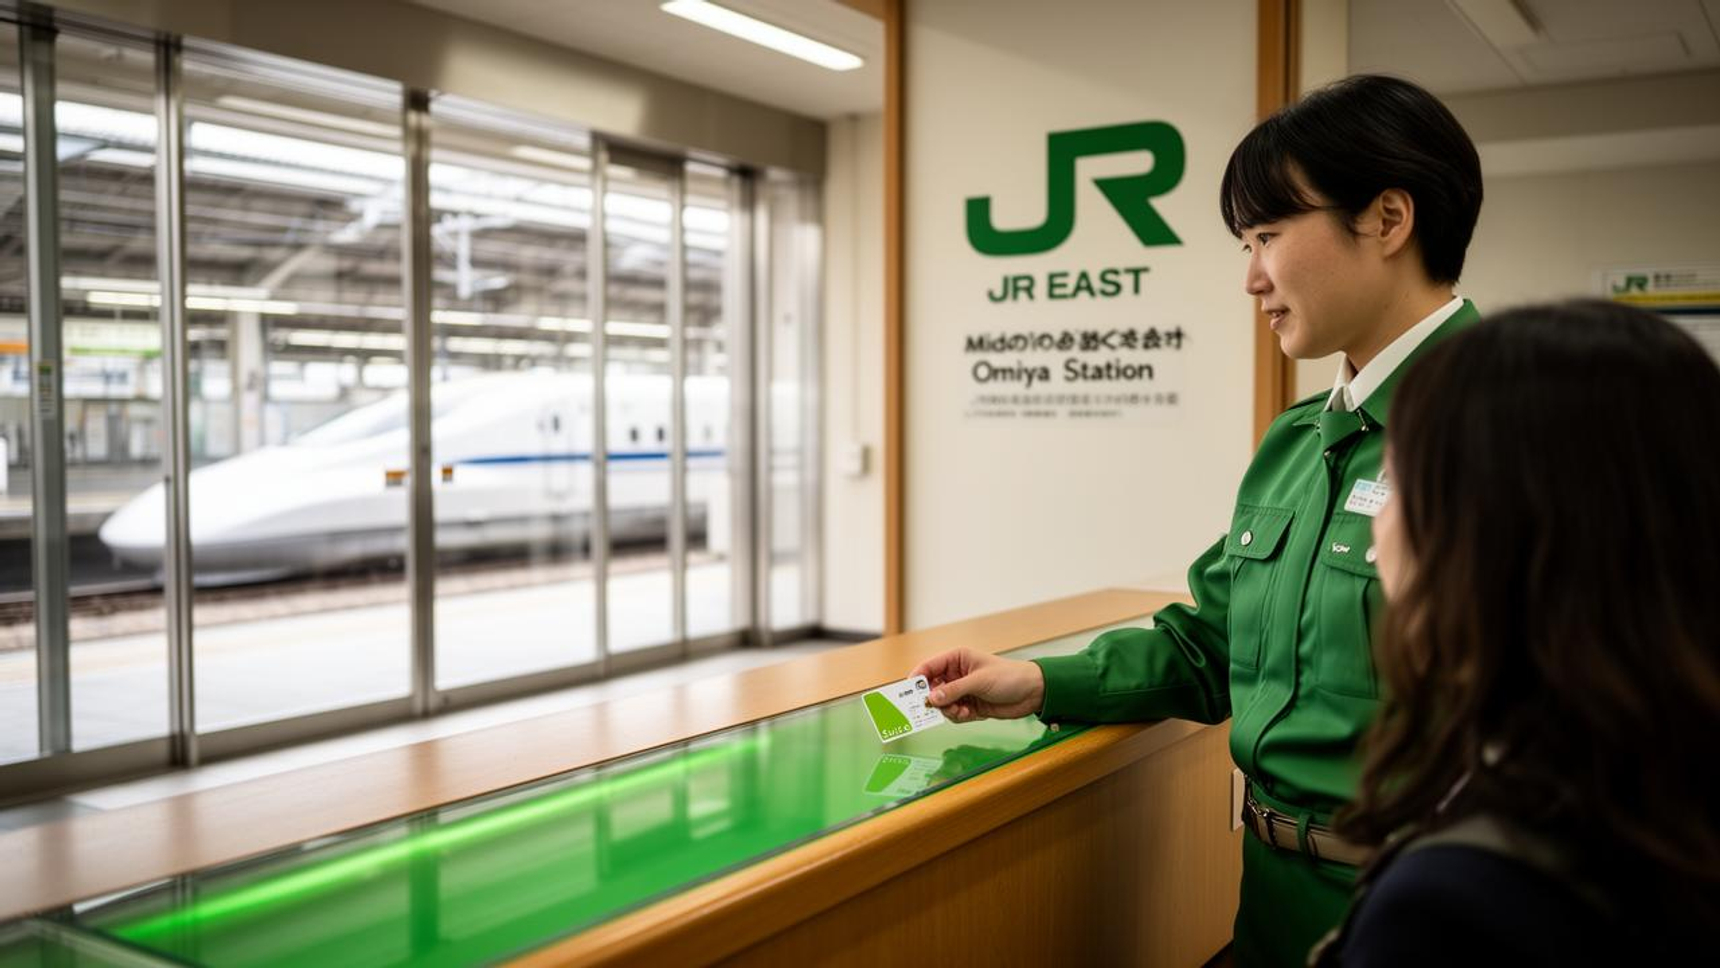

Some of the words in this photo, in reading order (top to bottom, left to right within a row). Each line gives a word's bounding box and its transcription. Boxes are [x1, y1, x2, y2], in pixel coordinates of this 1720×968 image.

[965, 119, 1186, 257] JR
[987, 274, 1036, 304] JR
[1047, 267, 1151, 300] EAST
[1612, 274, 1649, 294] JR
[972, 360, 1051, 388] Omiya
[1063, 357, 1155, 383] Station
